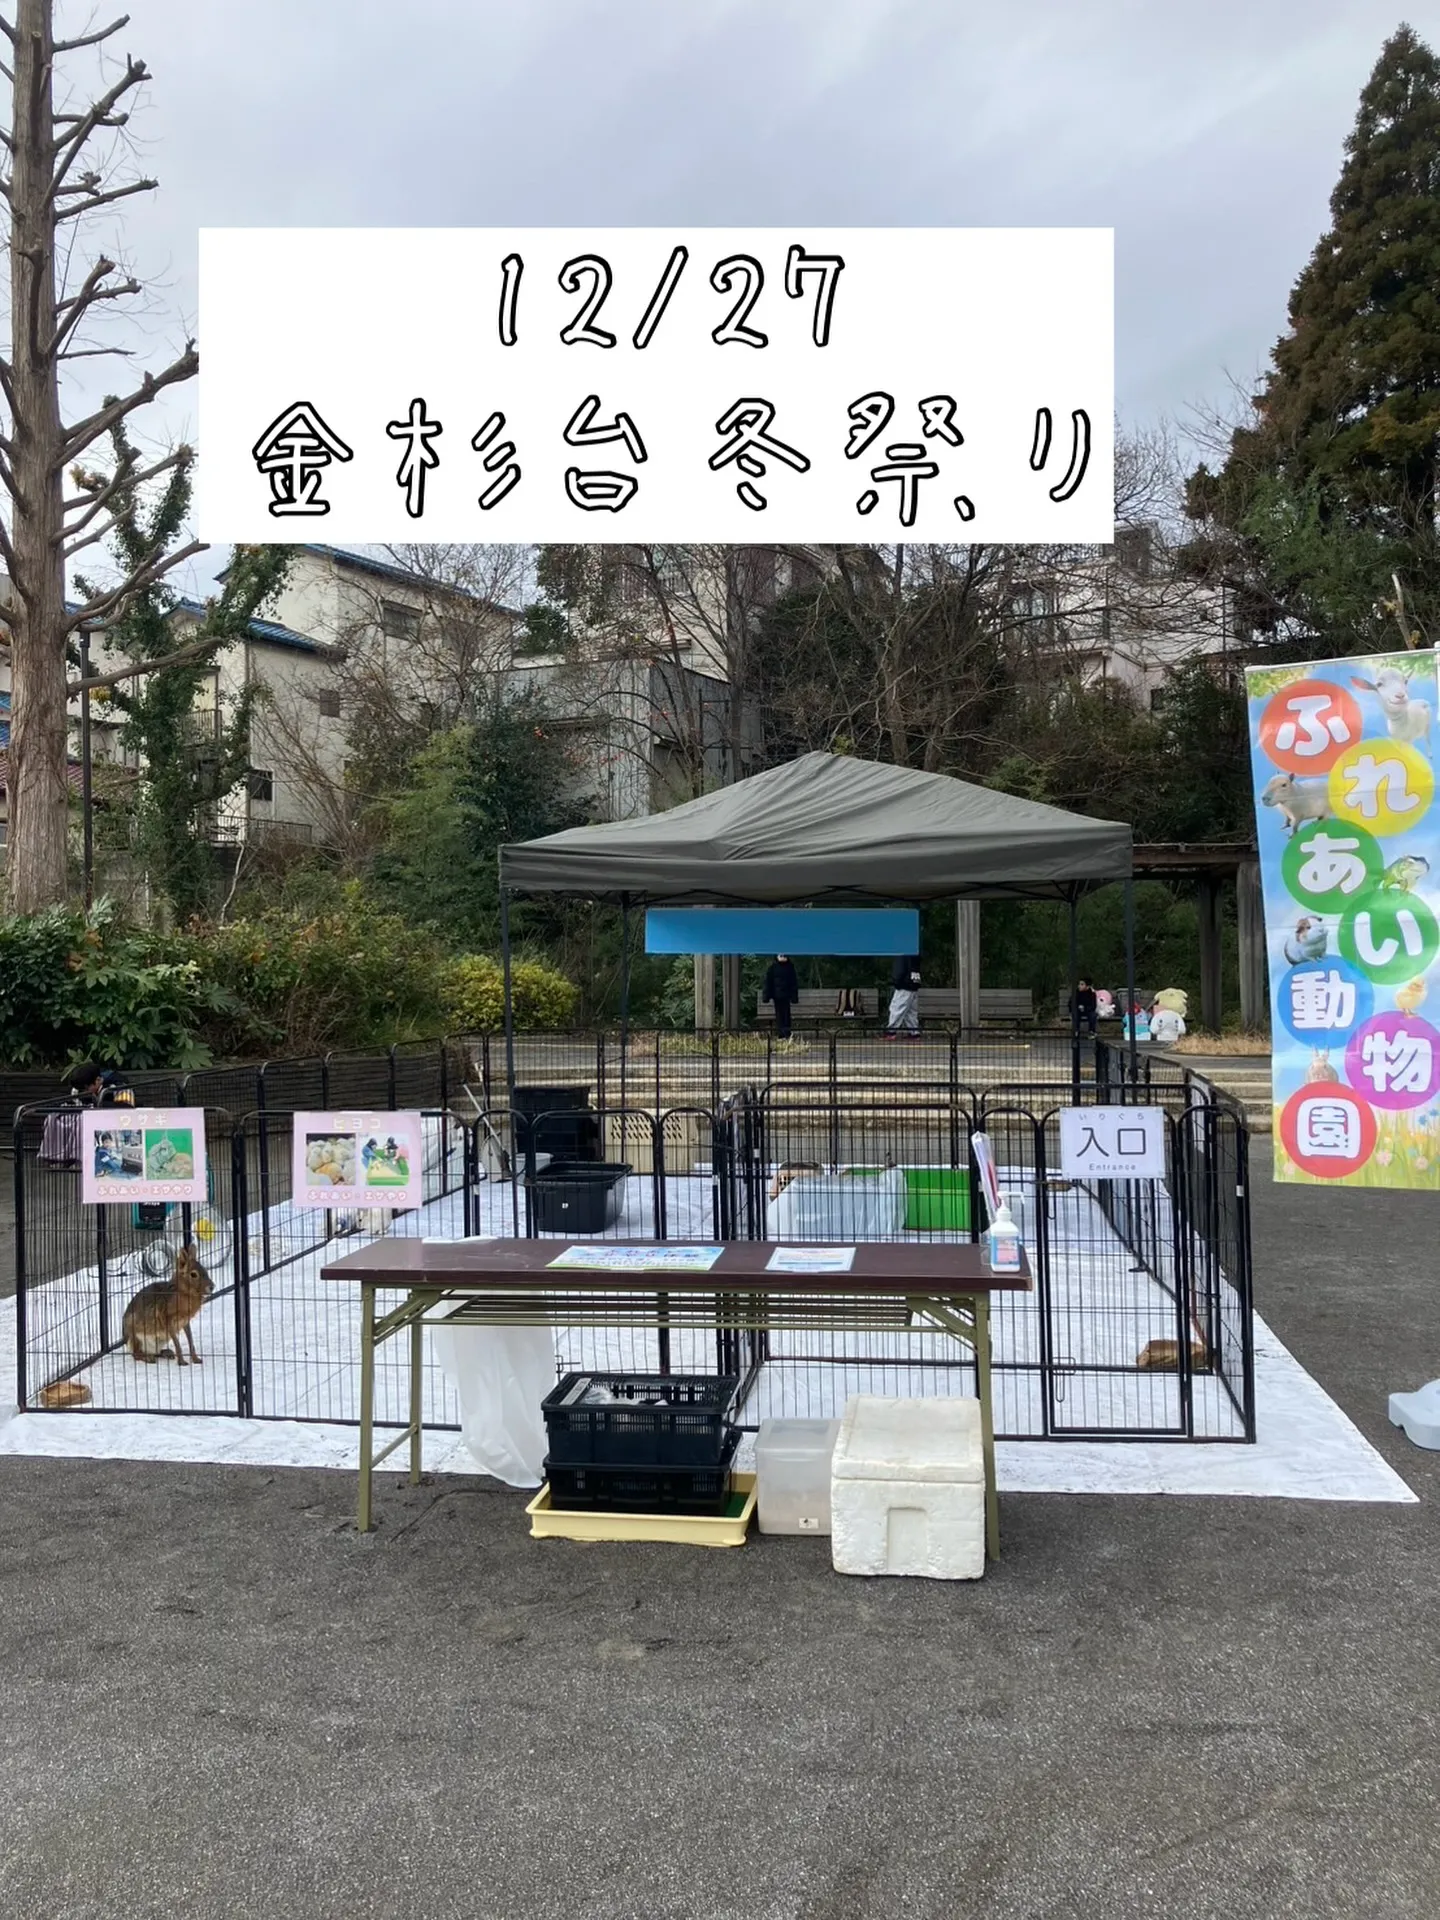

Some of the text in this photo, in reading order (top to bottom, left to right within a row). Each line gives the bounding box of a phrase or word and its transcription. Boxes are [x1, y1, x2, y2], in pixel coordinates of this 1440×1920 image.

[1275, 694, 1432, 1158] ふれあい動物園
[119, 1114, 167, 1126] ウサギ
[1078, 1112, 1145, 1121] いりぐち
[333, 1118, 381, 1129] ヒヨコ
[1076, 1127, 1146, 1157] 入口
[1088, 1162, 1137, 1172] Entrance
